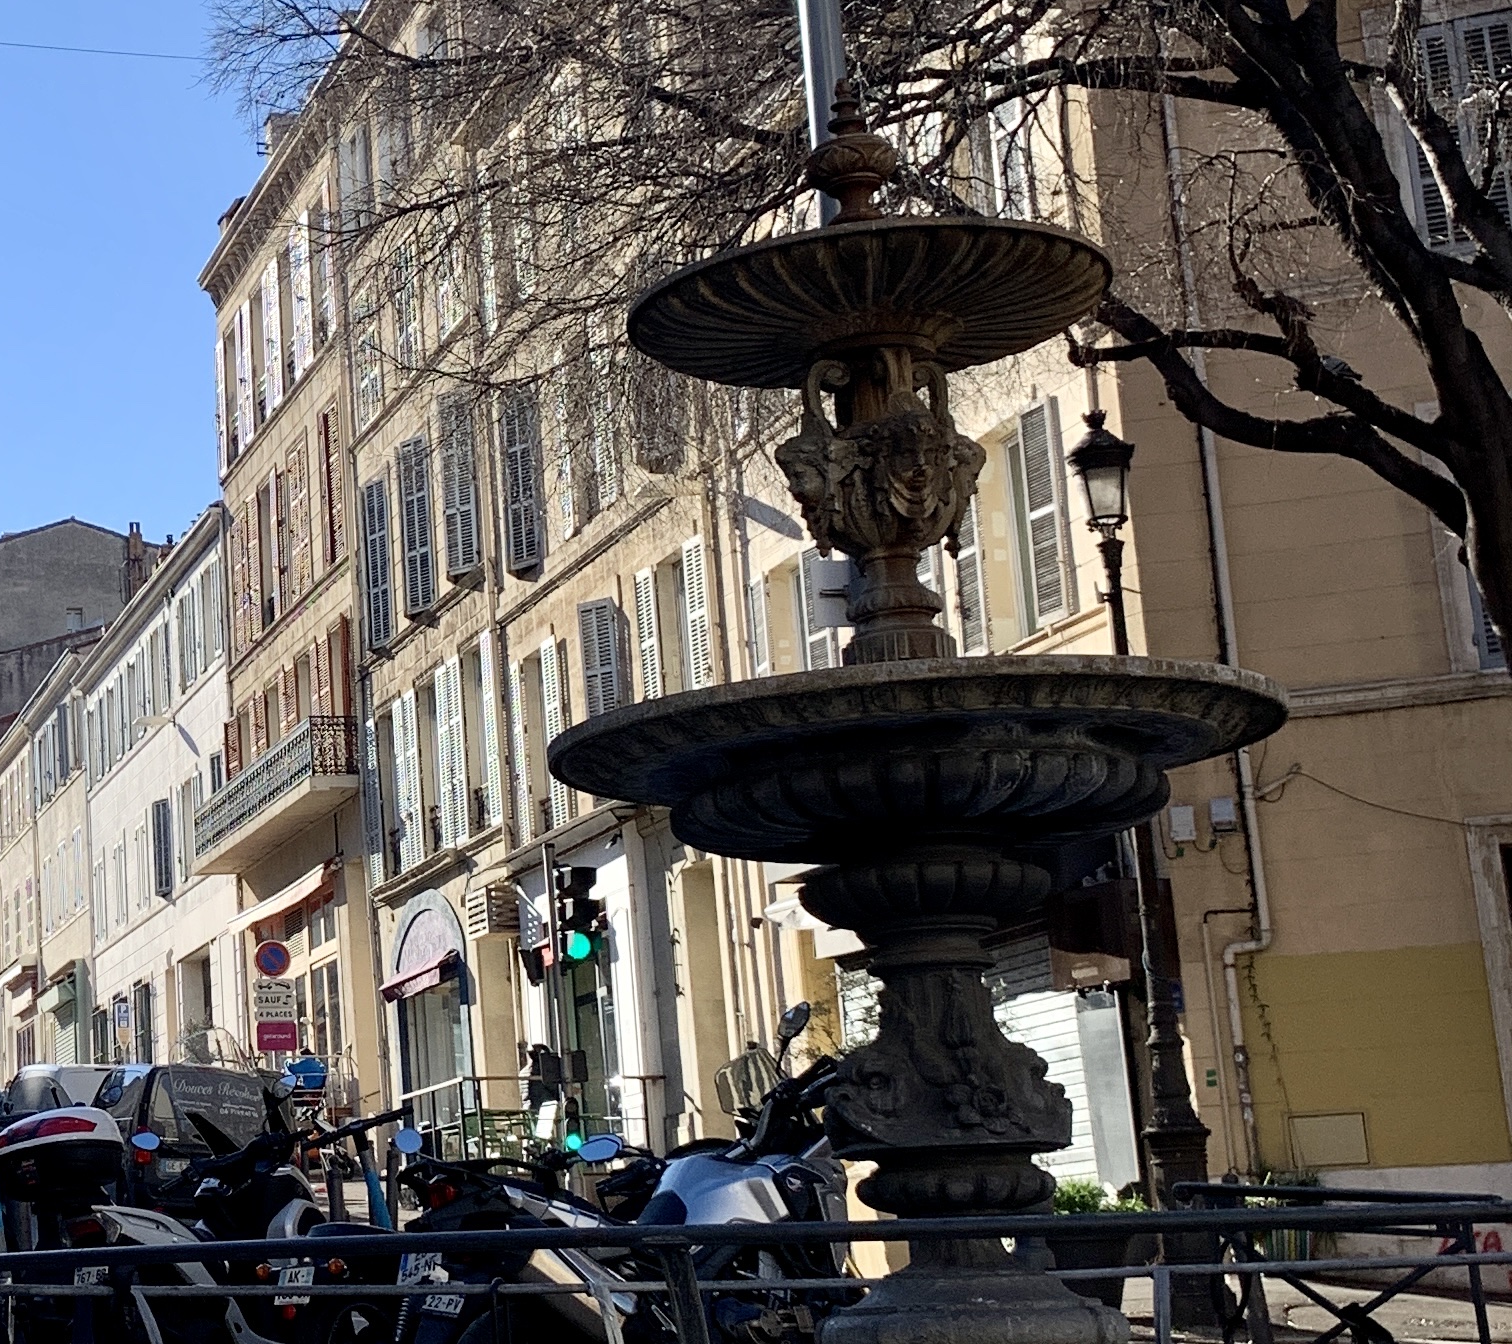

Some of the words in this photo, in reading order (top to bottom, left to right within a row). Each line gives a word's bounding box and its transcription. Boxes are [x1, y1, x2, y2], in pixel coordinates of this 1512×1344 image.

[257, 996, 281, 1004] SAUF
[259, 1010, 264, 1018] 4
[265, 1010, 293, 1018] PLACES
